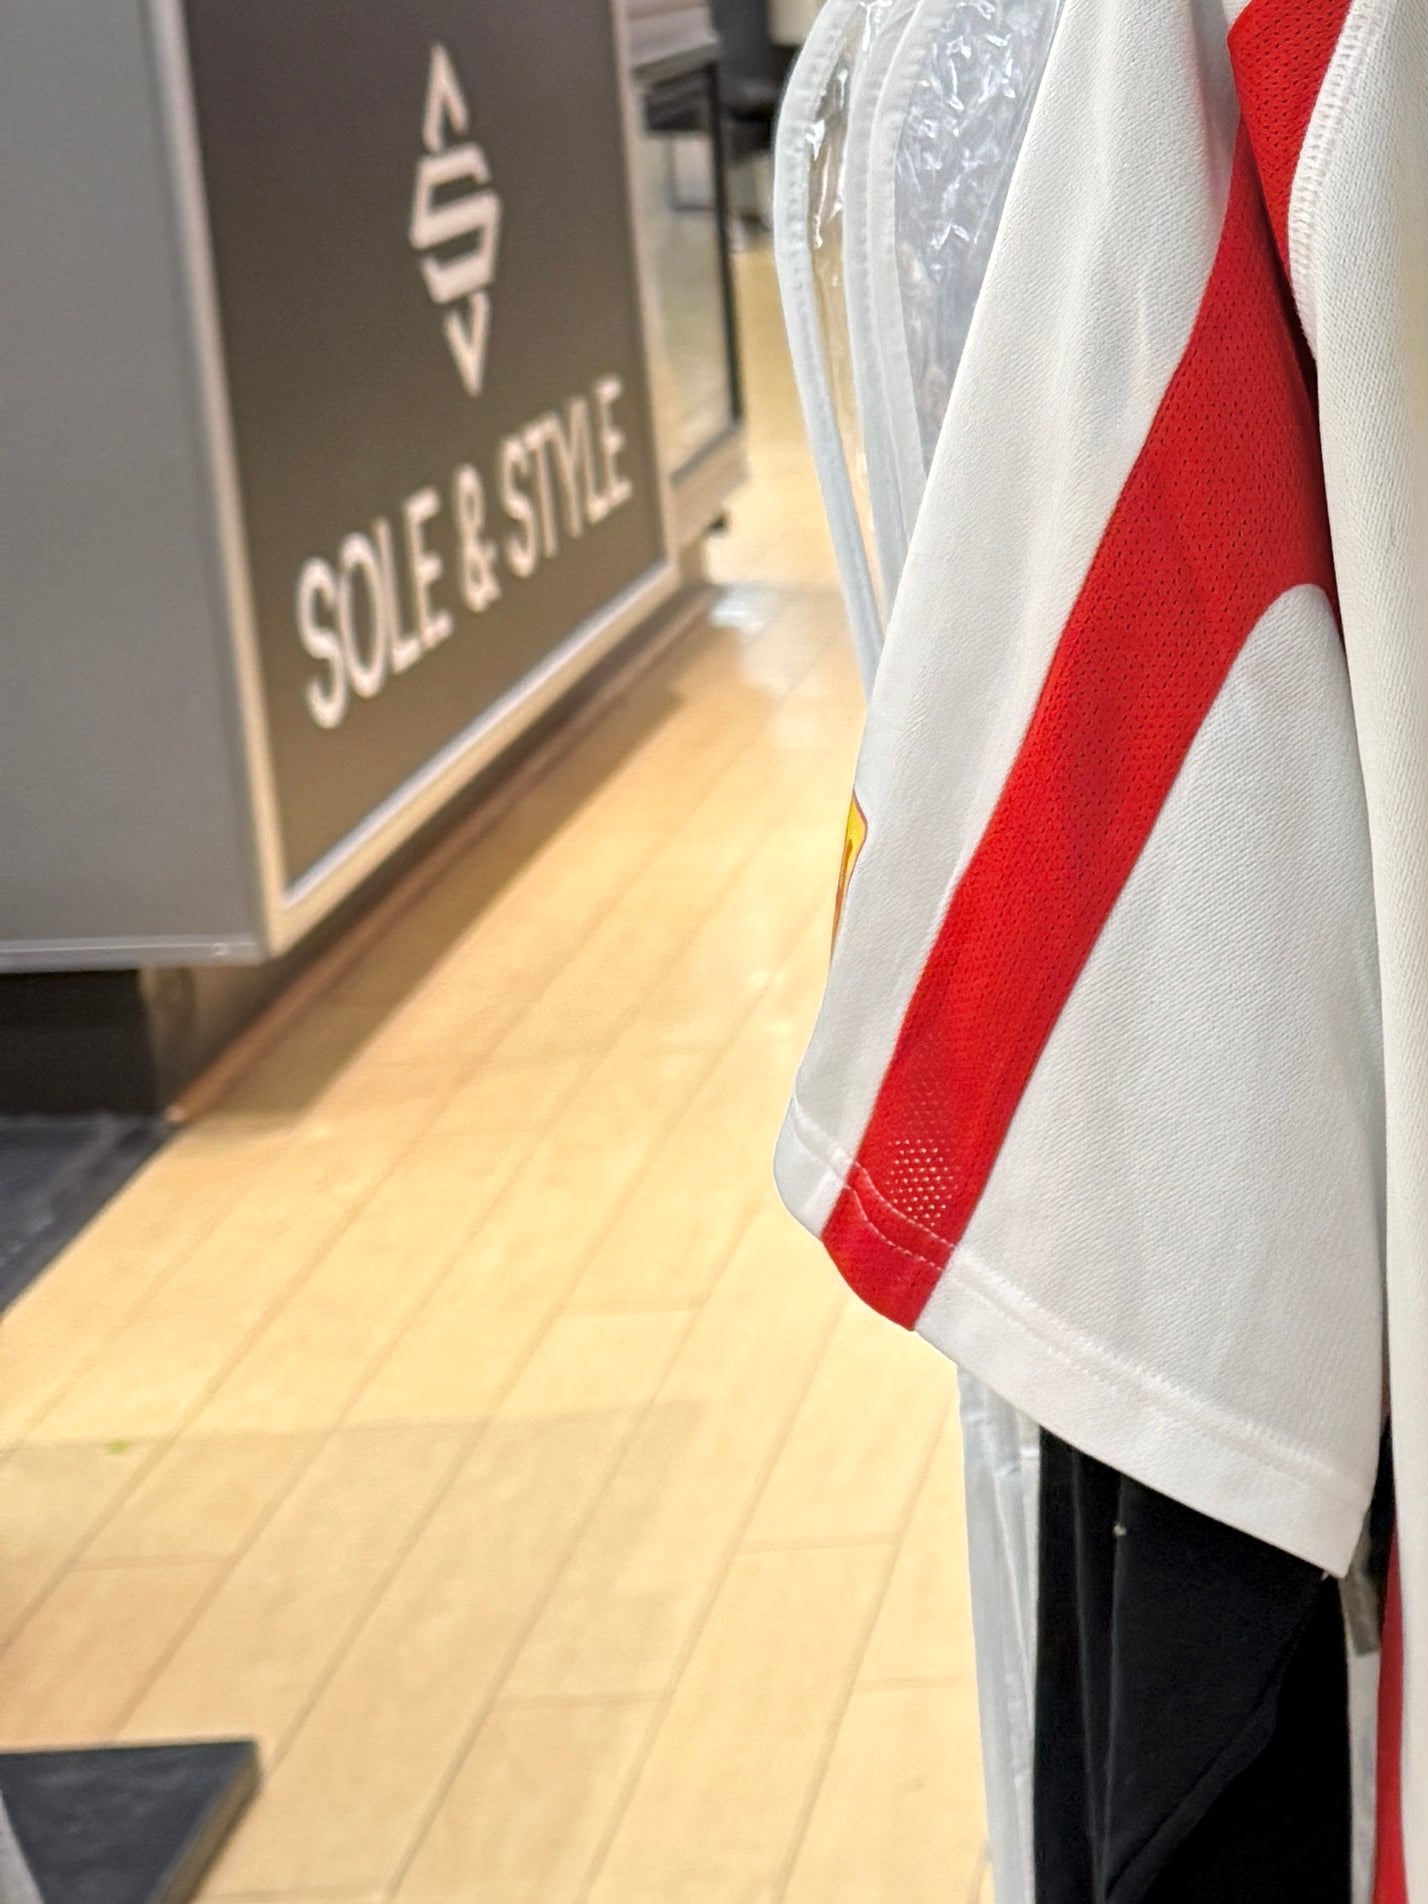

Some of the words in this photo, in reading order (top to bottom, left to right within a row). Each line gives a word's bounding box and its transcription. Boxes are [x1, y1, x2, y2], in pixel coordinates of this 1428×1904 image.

[298, 487, 453, 729] SOLE
[454, 464, 500, 612] &
[502, 375, 633, 578] STYLE
